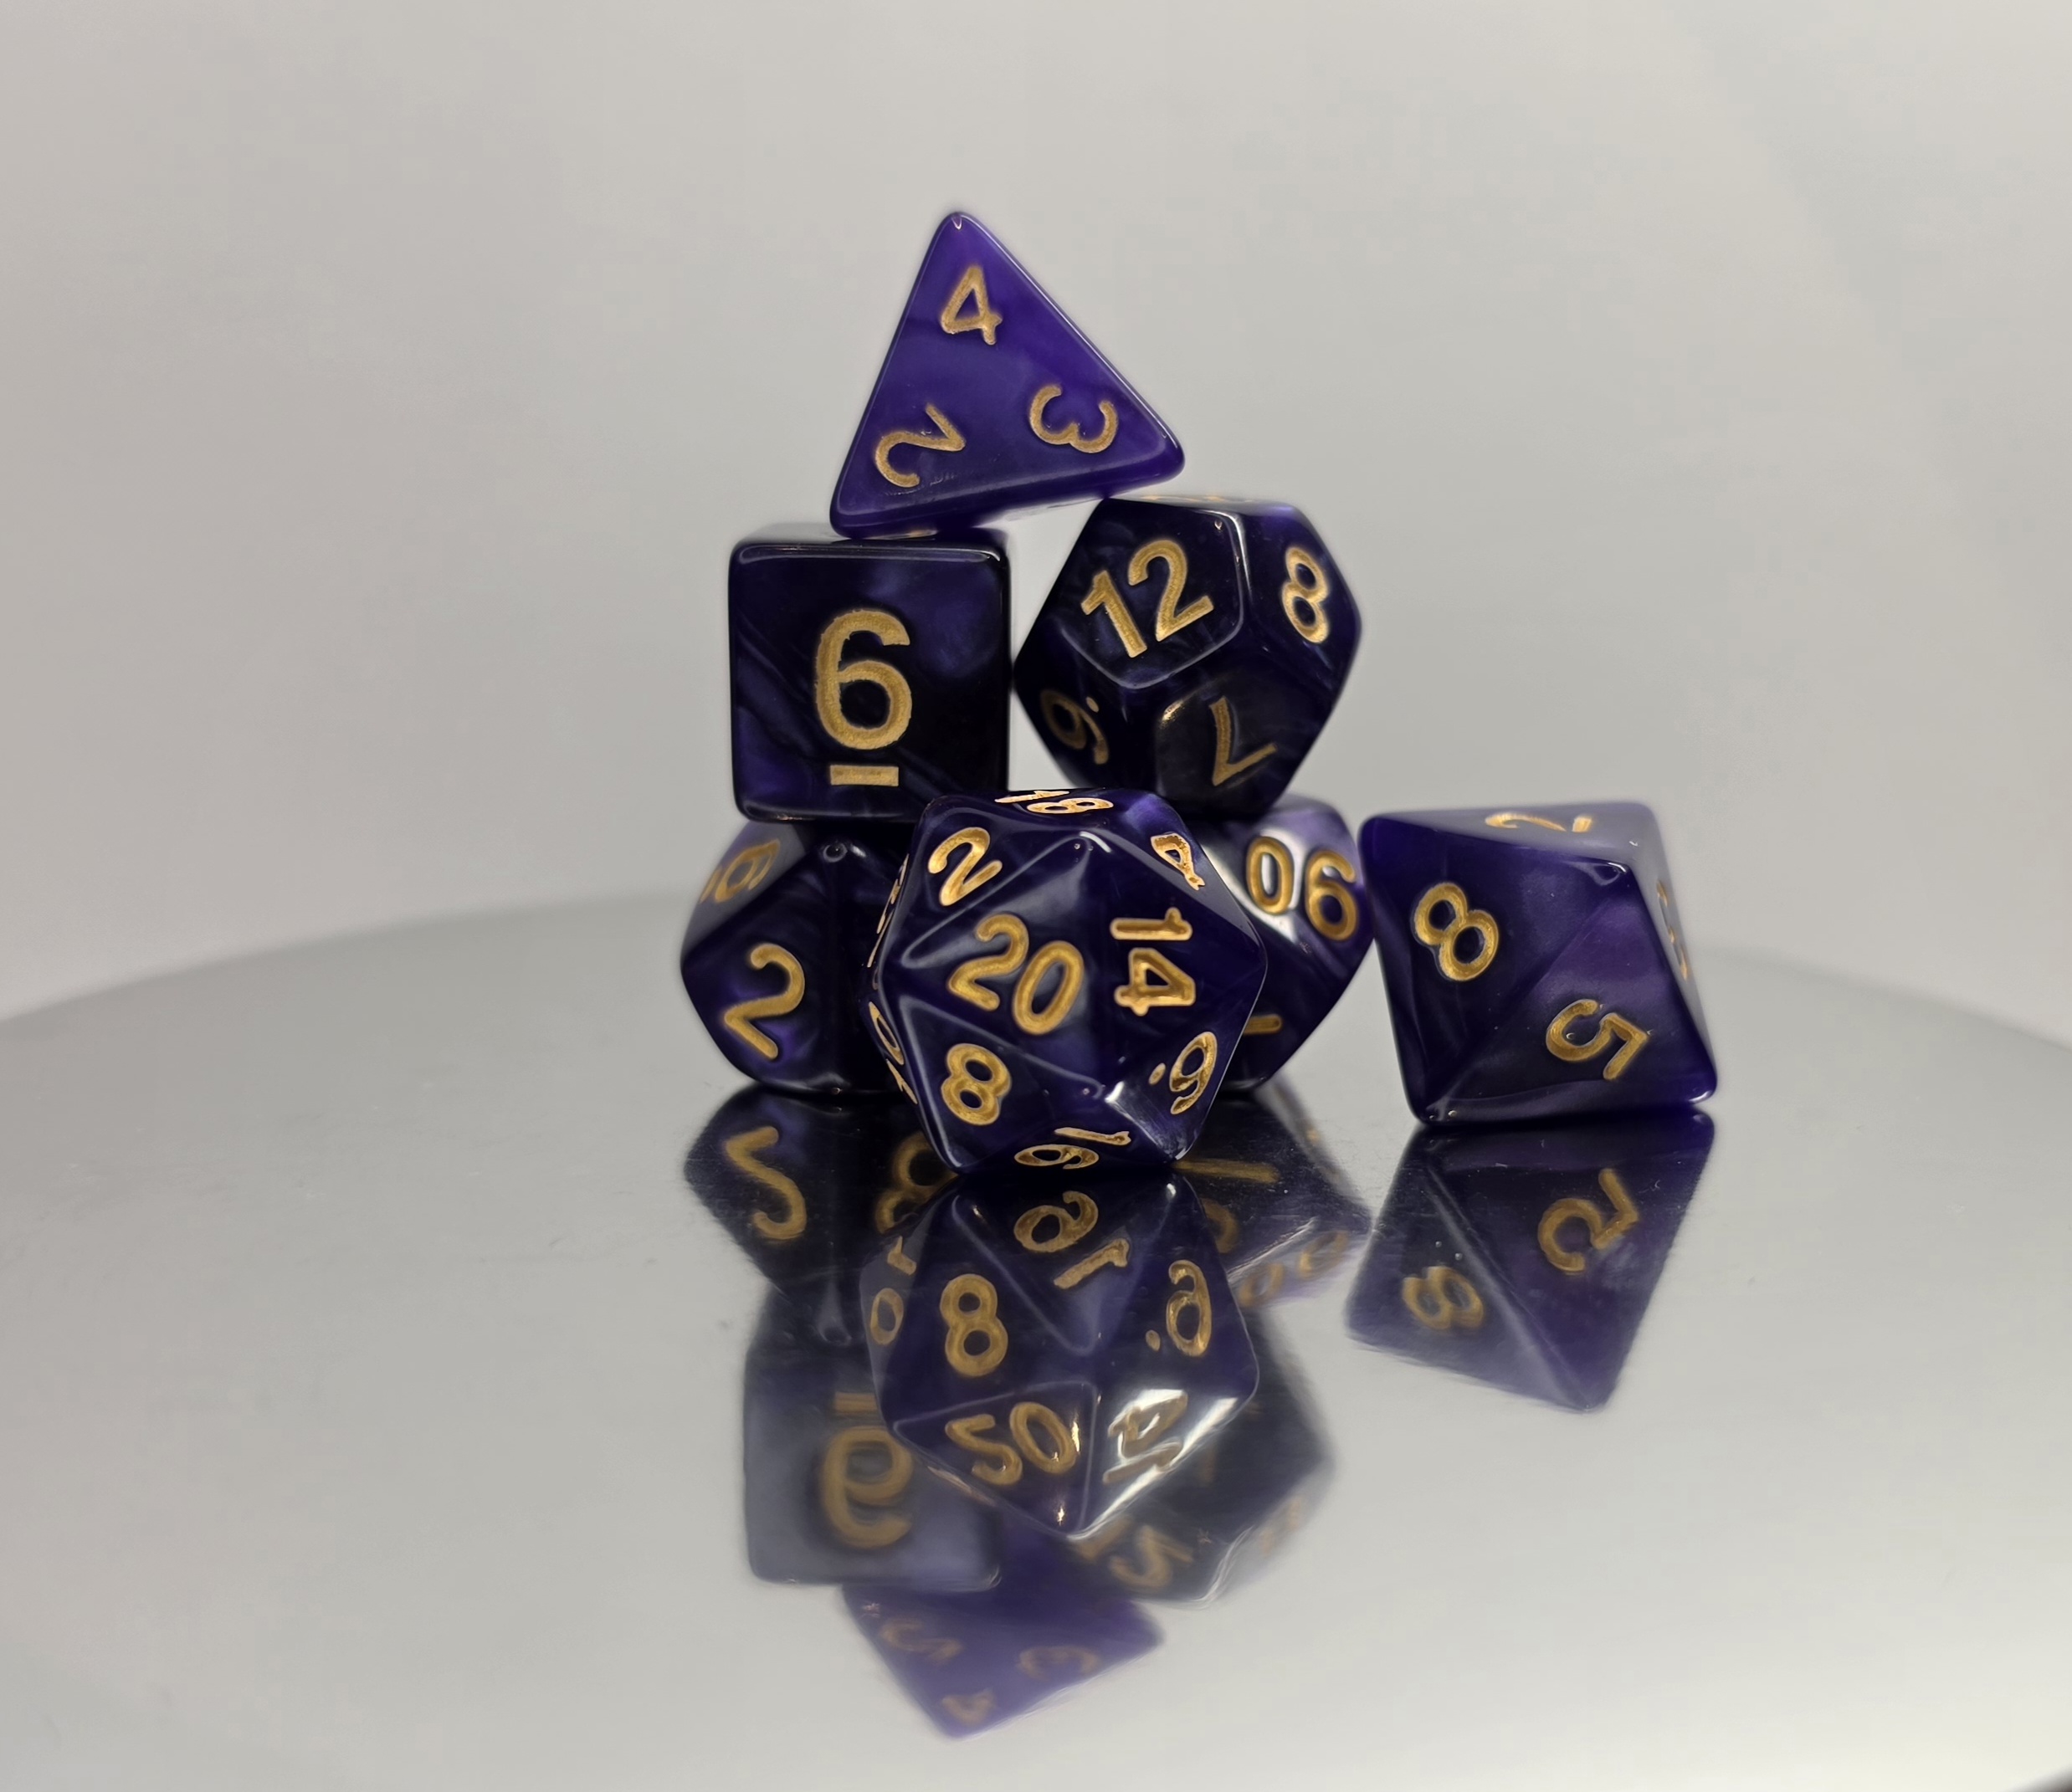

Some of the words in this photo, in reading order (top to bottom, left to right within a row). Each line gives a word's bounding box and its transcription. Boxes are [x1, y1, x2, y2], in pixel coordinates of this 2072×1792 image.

[940, 265, 1003, 346] 4
[874, 404, 967, 489] 2
[1028, 384, 1120, 454] 3
[1080, 539, 1215, 659] 12
[1280, 545, 1331, 644] 8
[1209, 696, 1279, 786] 7
[927, 827, 1003, 907] 2
[946, 913, 1085, 1036] 20
[1110, 907, 1197, 1016] 14
[1413, 882, 1500, 982] 8
[721, 942, 807, 1060] 2
[1544, 998, 1649, 1081] 5
[941, 1042, 1012, 1126] 8
